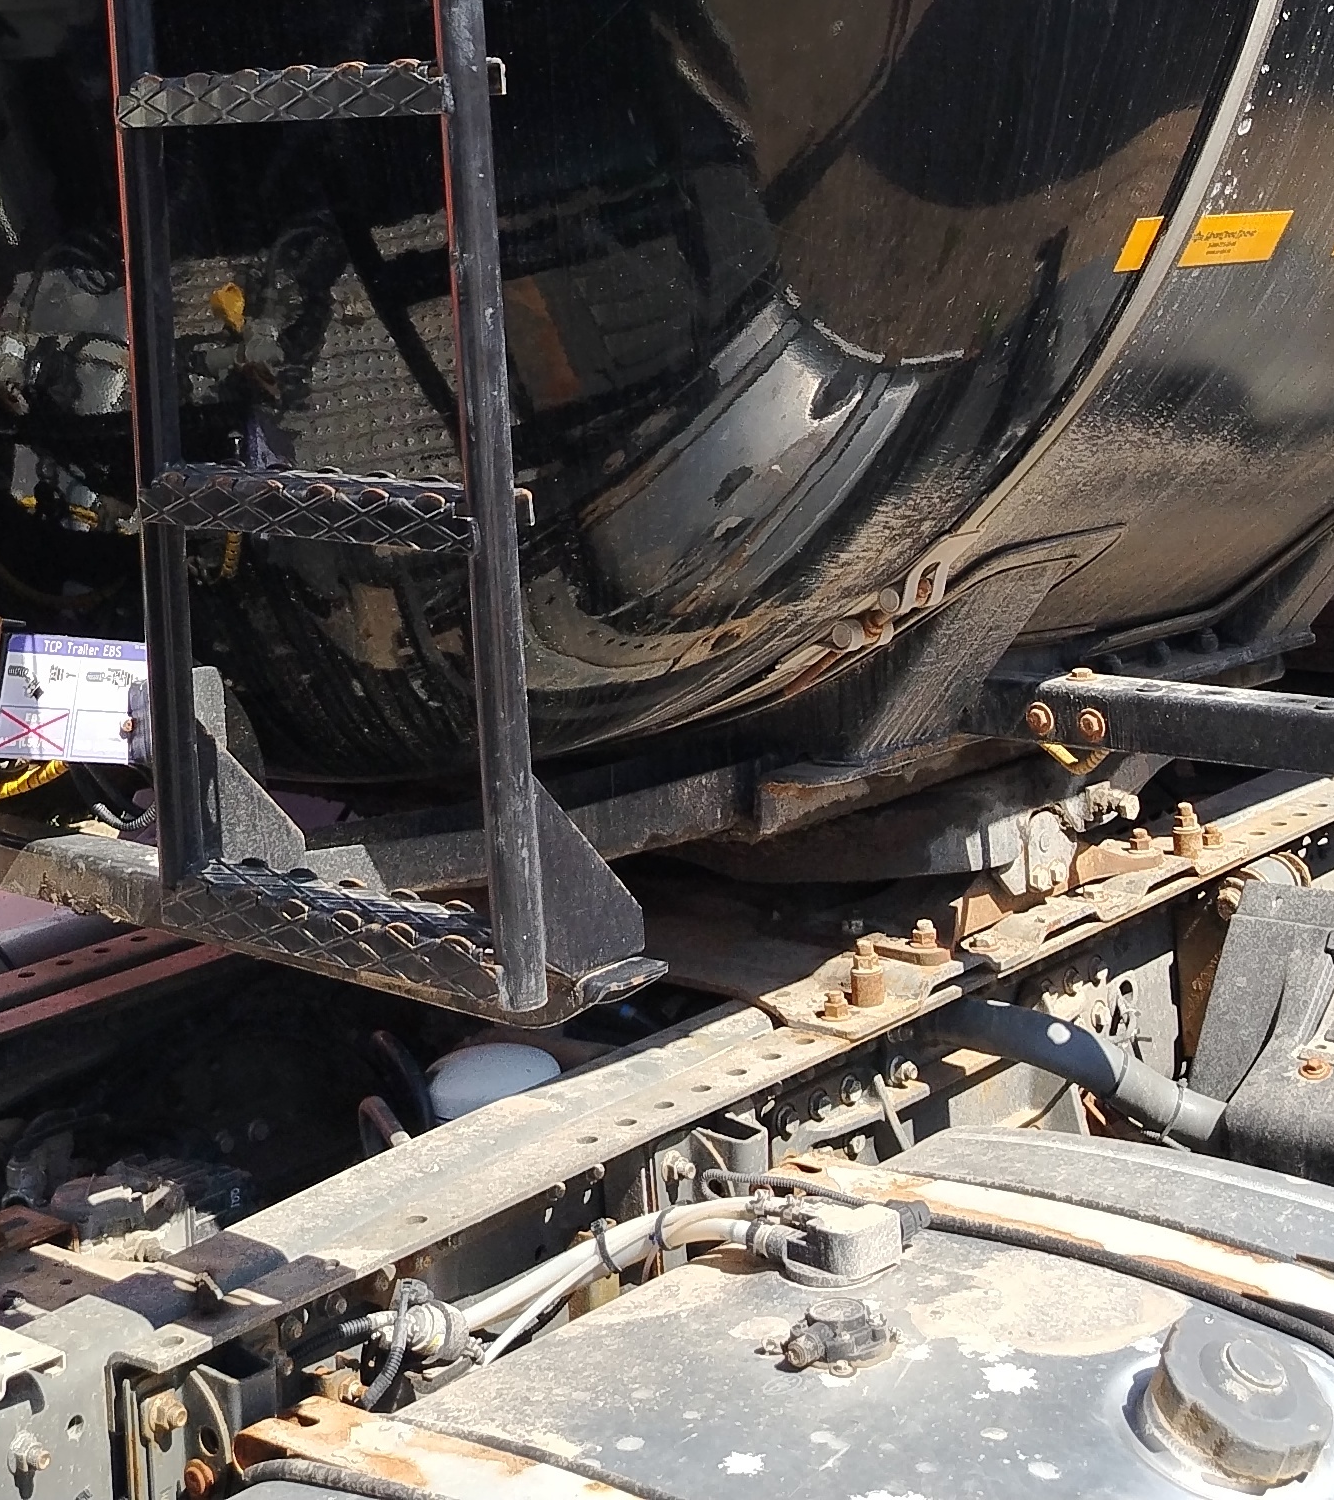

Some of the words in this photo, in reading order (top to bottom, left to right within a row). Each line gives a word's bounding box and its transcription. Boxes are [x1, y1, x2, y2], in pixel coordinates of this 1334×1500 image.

[44, 640, 62, 653] TCP
[68, 641, 99, 656] Trailer
[103, 645, 122, 658] EBS
